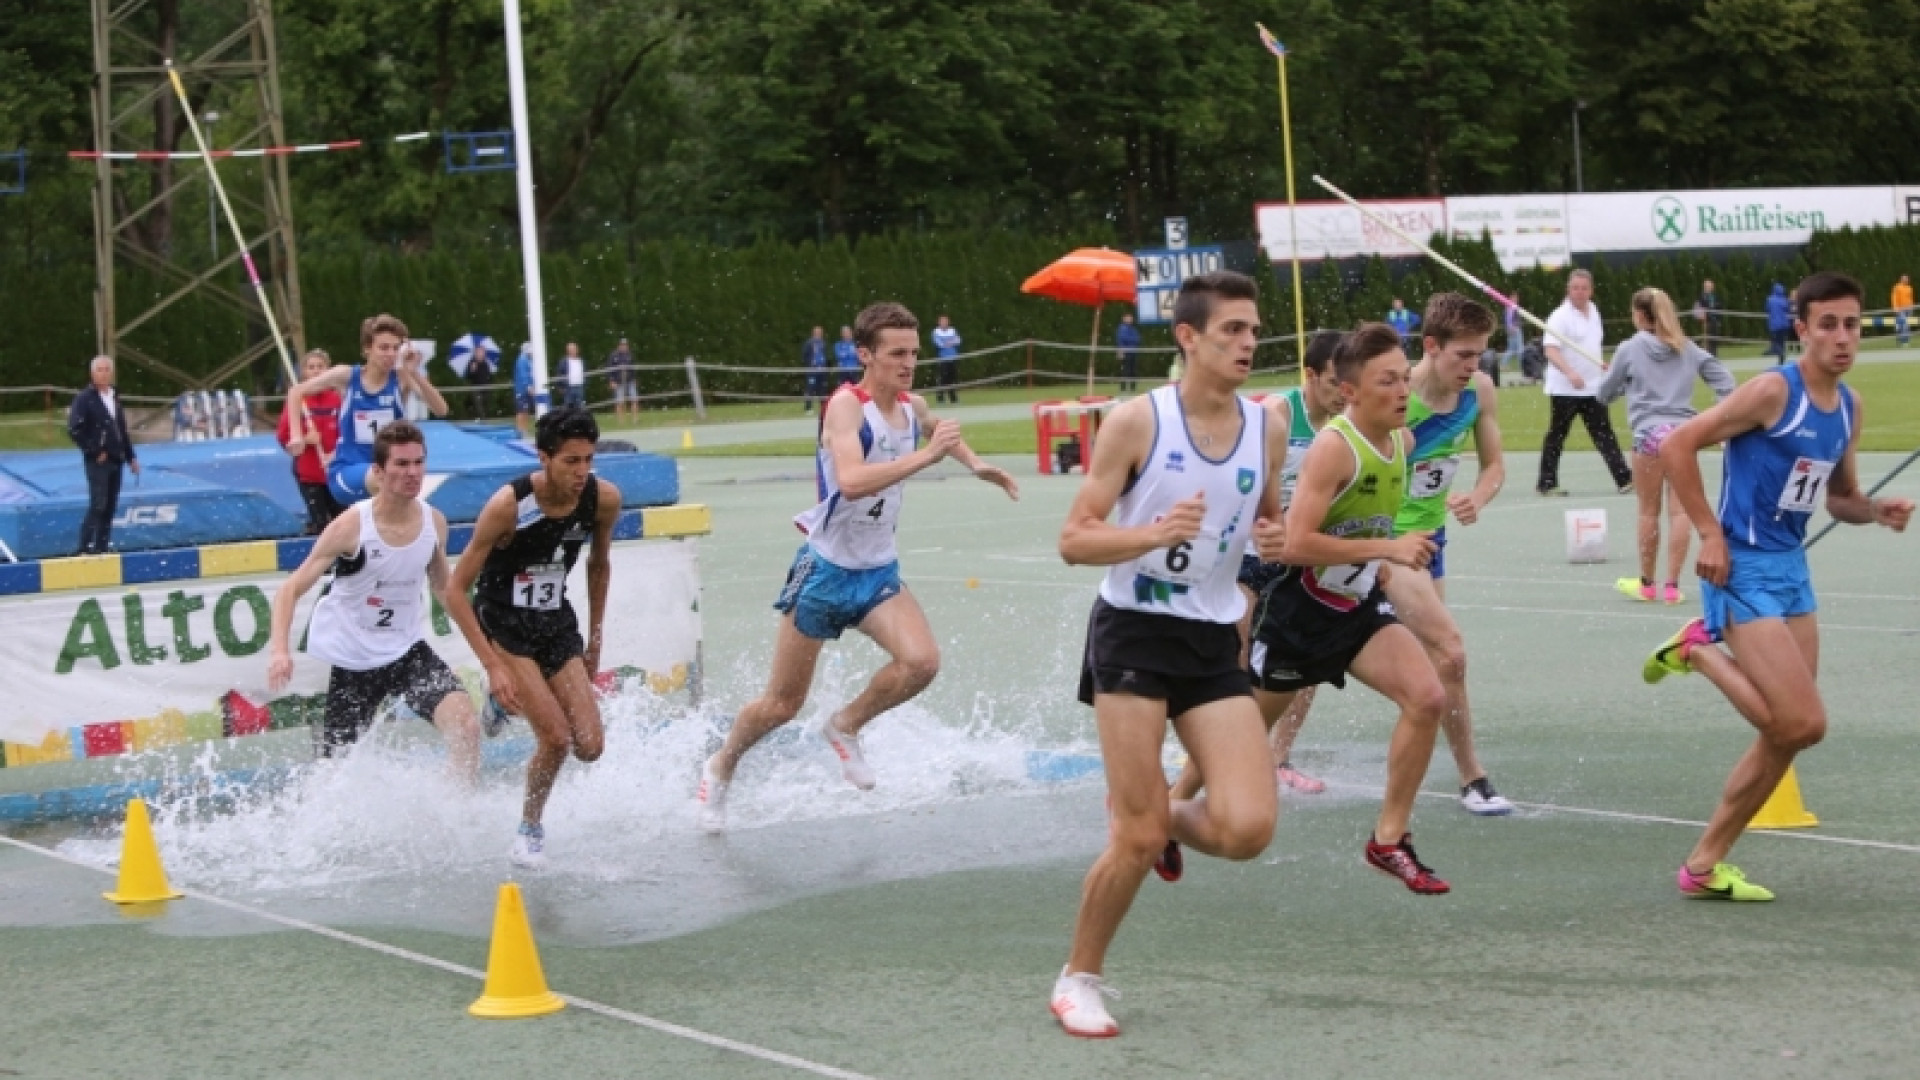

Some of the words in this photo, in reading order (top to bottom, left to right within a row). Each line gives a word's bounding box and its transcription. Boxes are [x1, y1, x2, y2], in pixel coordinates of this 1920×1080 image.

[1697, 203, 1825, 233] Raiffeisen
[1426, 469, 1443, 490] 3
[1795, 474, 1822, 504] 11
[867, 498, 886, 520] 4
[1166, 541, 1193, 574] 6
[1343, 561, 1368, 586] 7
[521, 582, 555, 606] 13
[374, 609, 394, 627] 2
